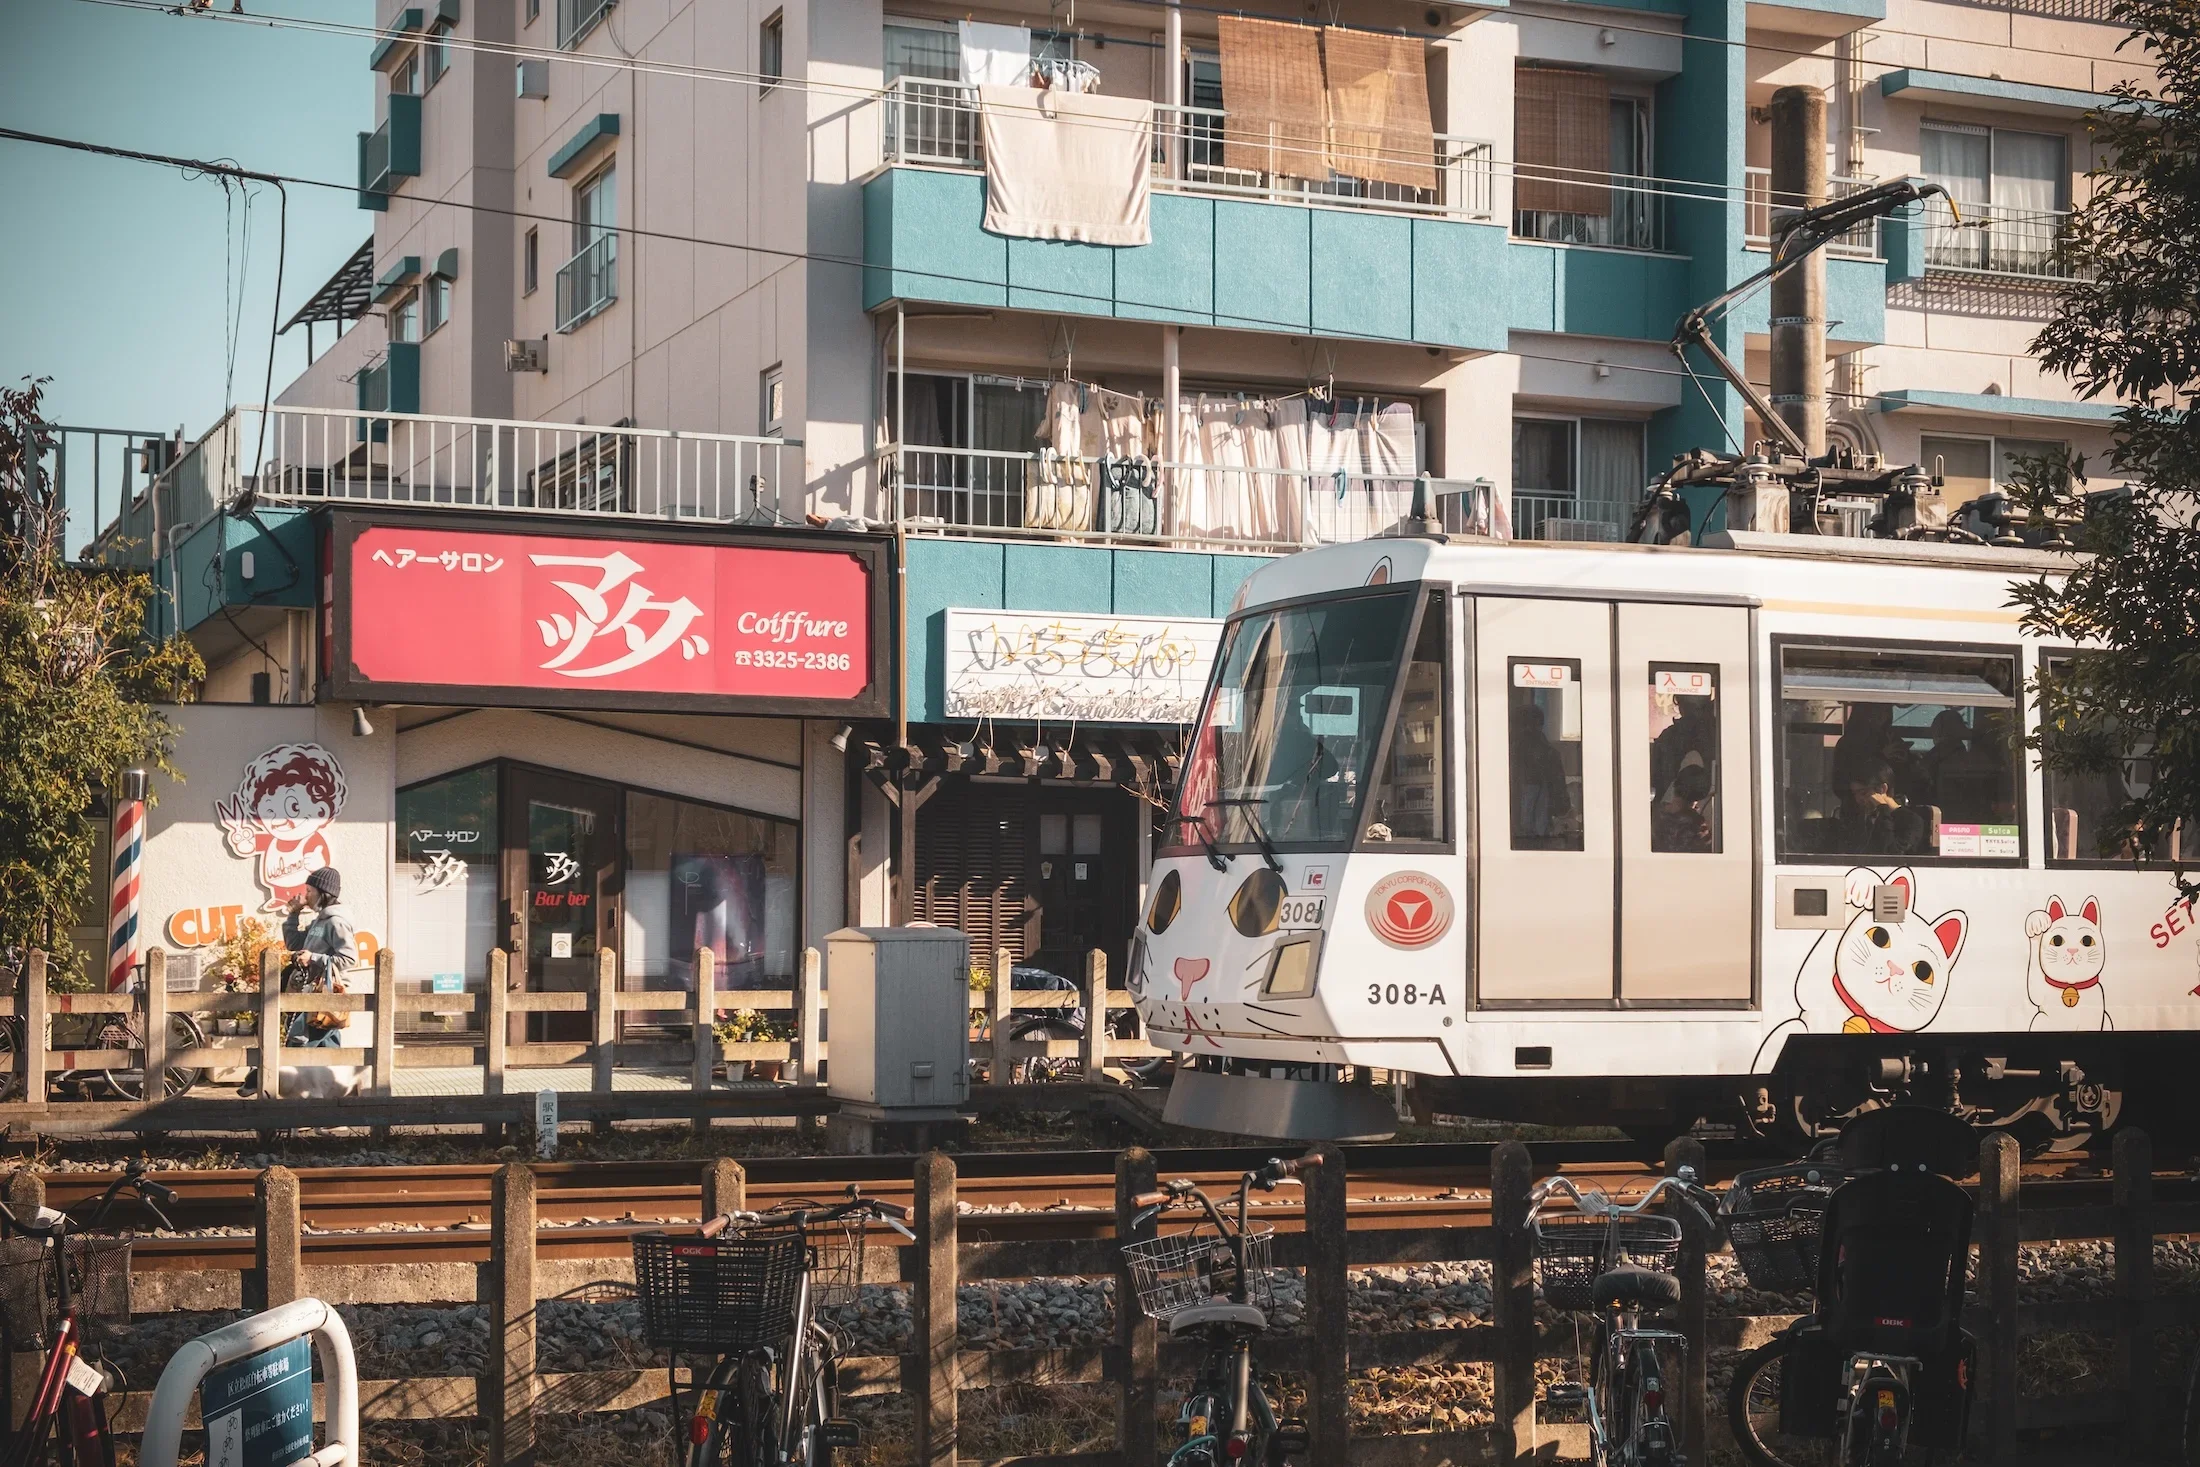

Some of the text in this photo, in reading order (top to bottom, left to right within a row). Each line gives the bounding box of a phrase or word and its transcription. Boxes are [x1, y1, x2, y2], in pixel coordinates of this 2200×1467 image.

[372, 548, 504, 573] ヘアーサロン
[736, 609, 849, 644] Coiffure
[1522, 665, 1563, 680] 入口
[1663, 673, 1703, 687] 入口
[410, 829, 480, 843] ヘアーサロン
[1948, 826, 1971, 834] PASMO
[1988, 827, 2011, 835] Suica
[1373, 875, 1447, 899] TOKYU CORPORATION
[1280, 901, 1317, 924] 308
[169, 904, 244, 948] CUT
[1366, 983, 1447, 1006] 308-A
[682, 1246, 704, 1255] OGK
